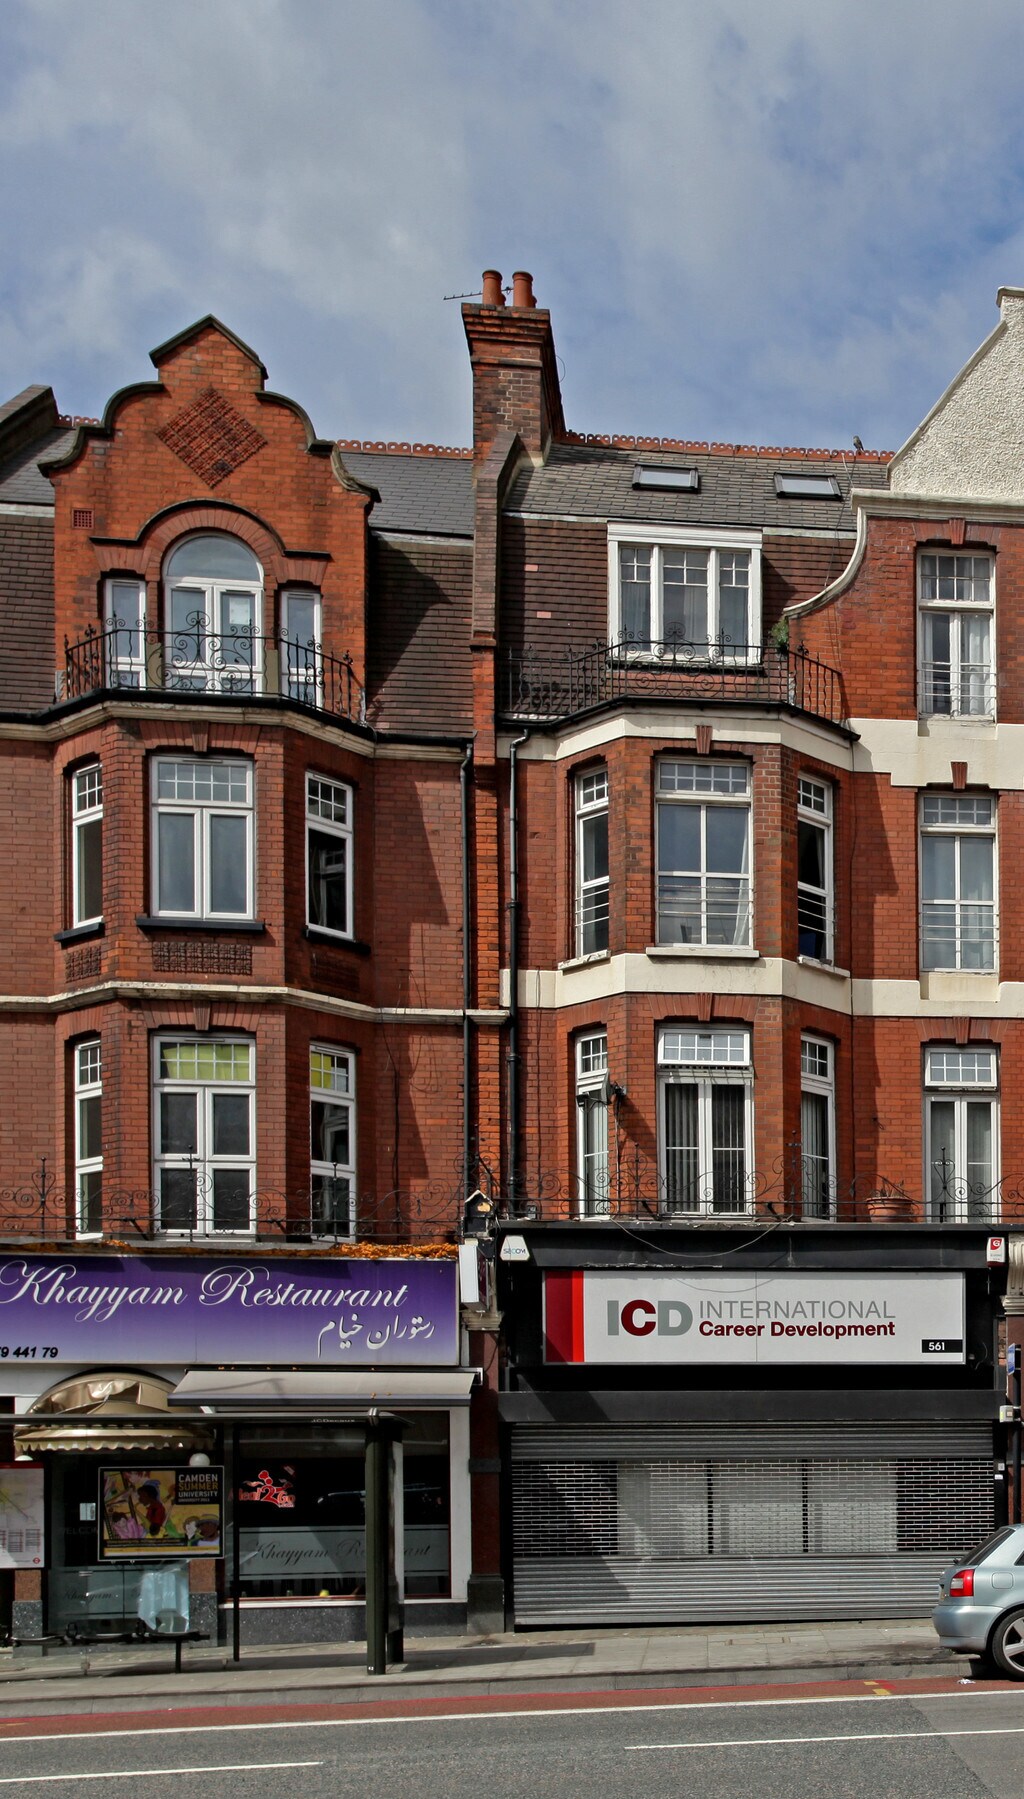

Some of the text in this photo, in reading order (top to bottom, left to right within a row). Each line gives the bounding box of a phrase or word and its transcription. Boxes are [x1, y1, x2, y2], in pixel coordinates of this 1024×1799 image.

[0, 1260, 409, 1322] Khayyam Restaurant
[607, 1299, 694, 1336] ICD
[700, 1300, 896, 1318] INTERNATIONAL
[366, 1314, 436, 1350] رستوران
[699, 1320, 896, 1339] Career Development
[13, 1347, 37, 1358] 441
[42, 1347, 59, 1358] 79
[928, 1342, 946, 1351] 561
[178, 1473, 218, 1482] CAMDEN
[178, 1482, 218, 1491] SUMMER
[256, 1541, 328, 1567] Khayyam
